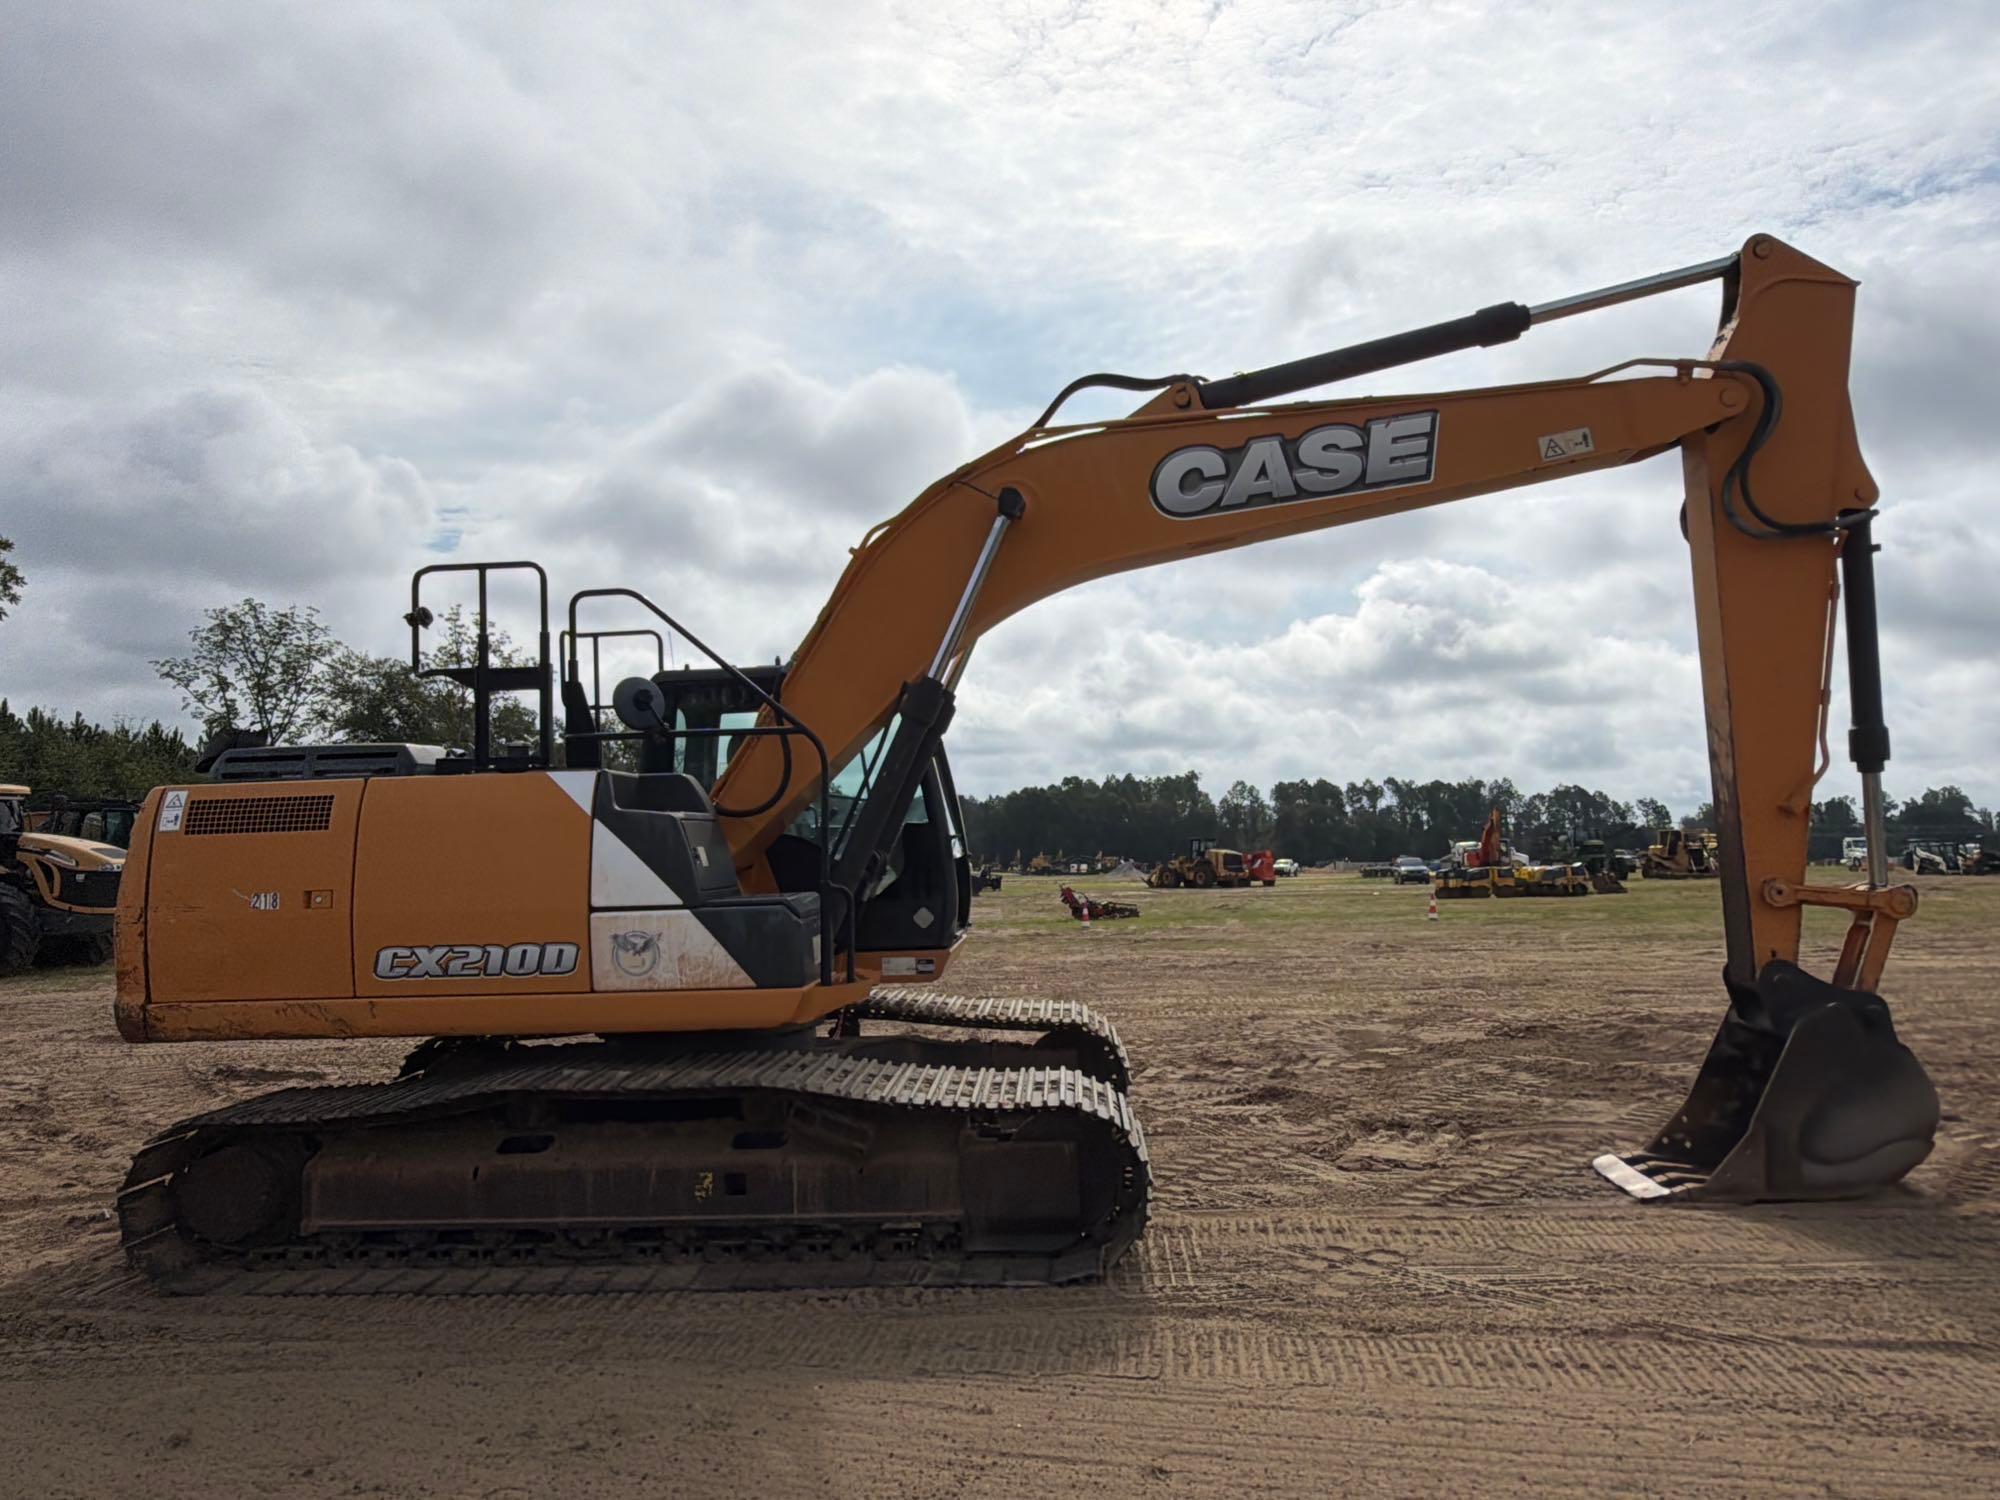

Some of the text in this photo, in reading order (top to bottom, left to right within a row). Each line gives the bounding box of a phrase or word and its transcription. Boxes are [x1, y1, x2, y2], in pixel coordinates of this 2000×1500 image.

[1152, 413, 1434, 515] CASE
[252, 892, 279, 910] 218
[375, 943, 580, 978] CX210D
